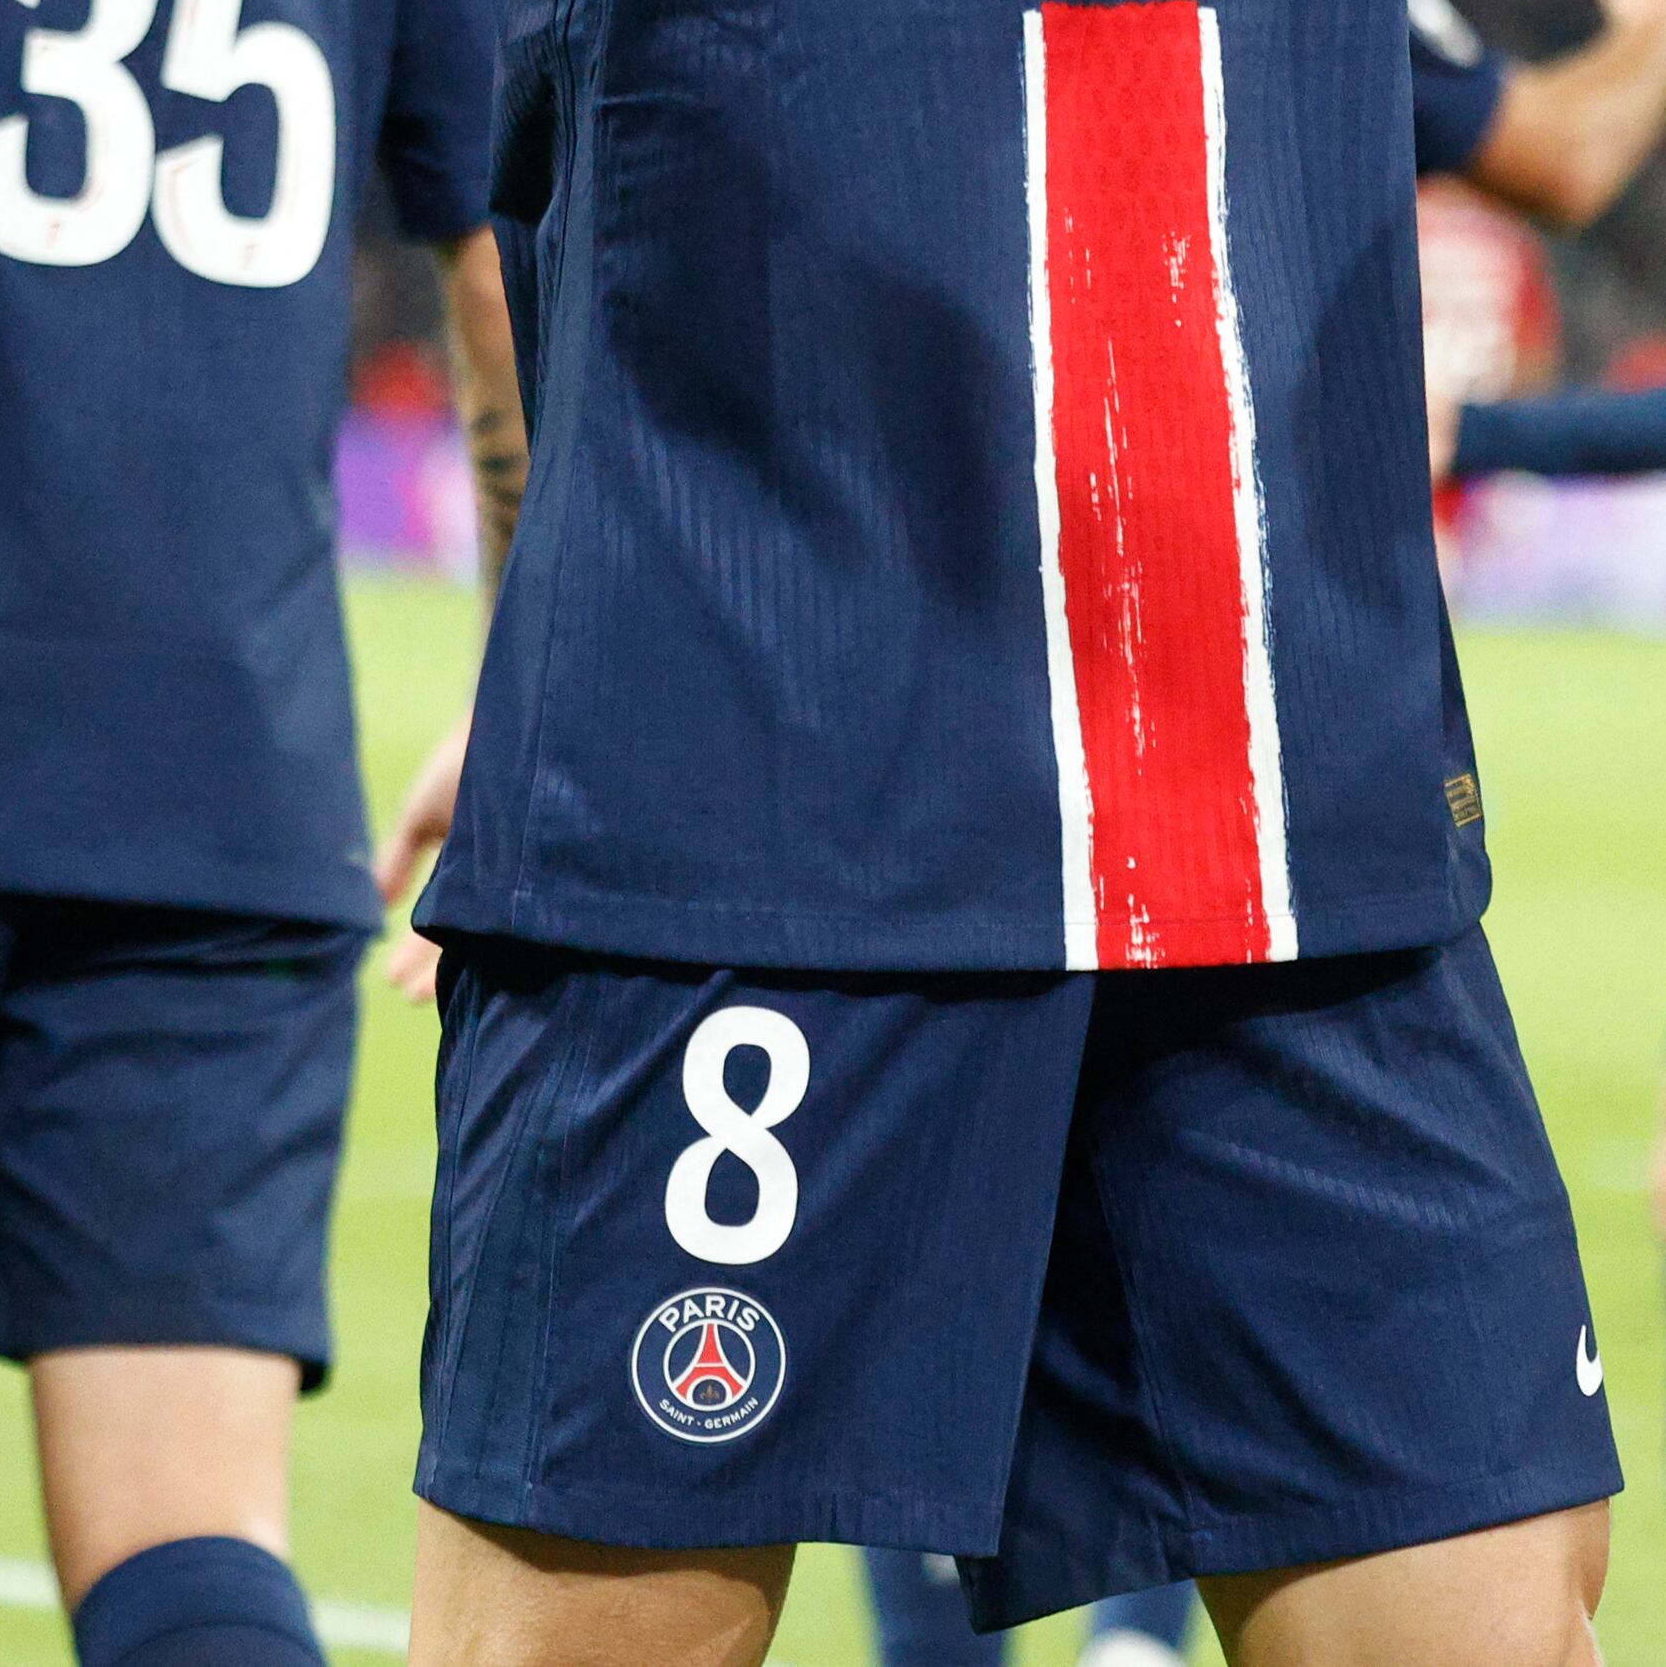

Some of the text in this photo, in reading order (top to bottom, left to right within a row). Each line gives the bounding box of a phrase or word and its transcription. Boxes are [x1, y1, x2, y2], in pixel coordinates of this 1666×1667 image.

[664, 1005, 811, 1265] 8
[658, 1295, 761, 1333] PARIS
[658, 1396, 760, 1431] SAINT GERMAIN
